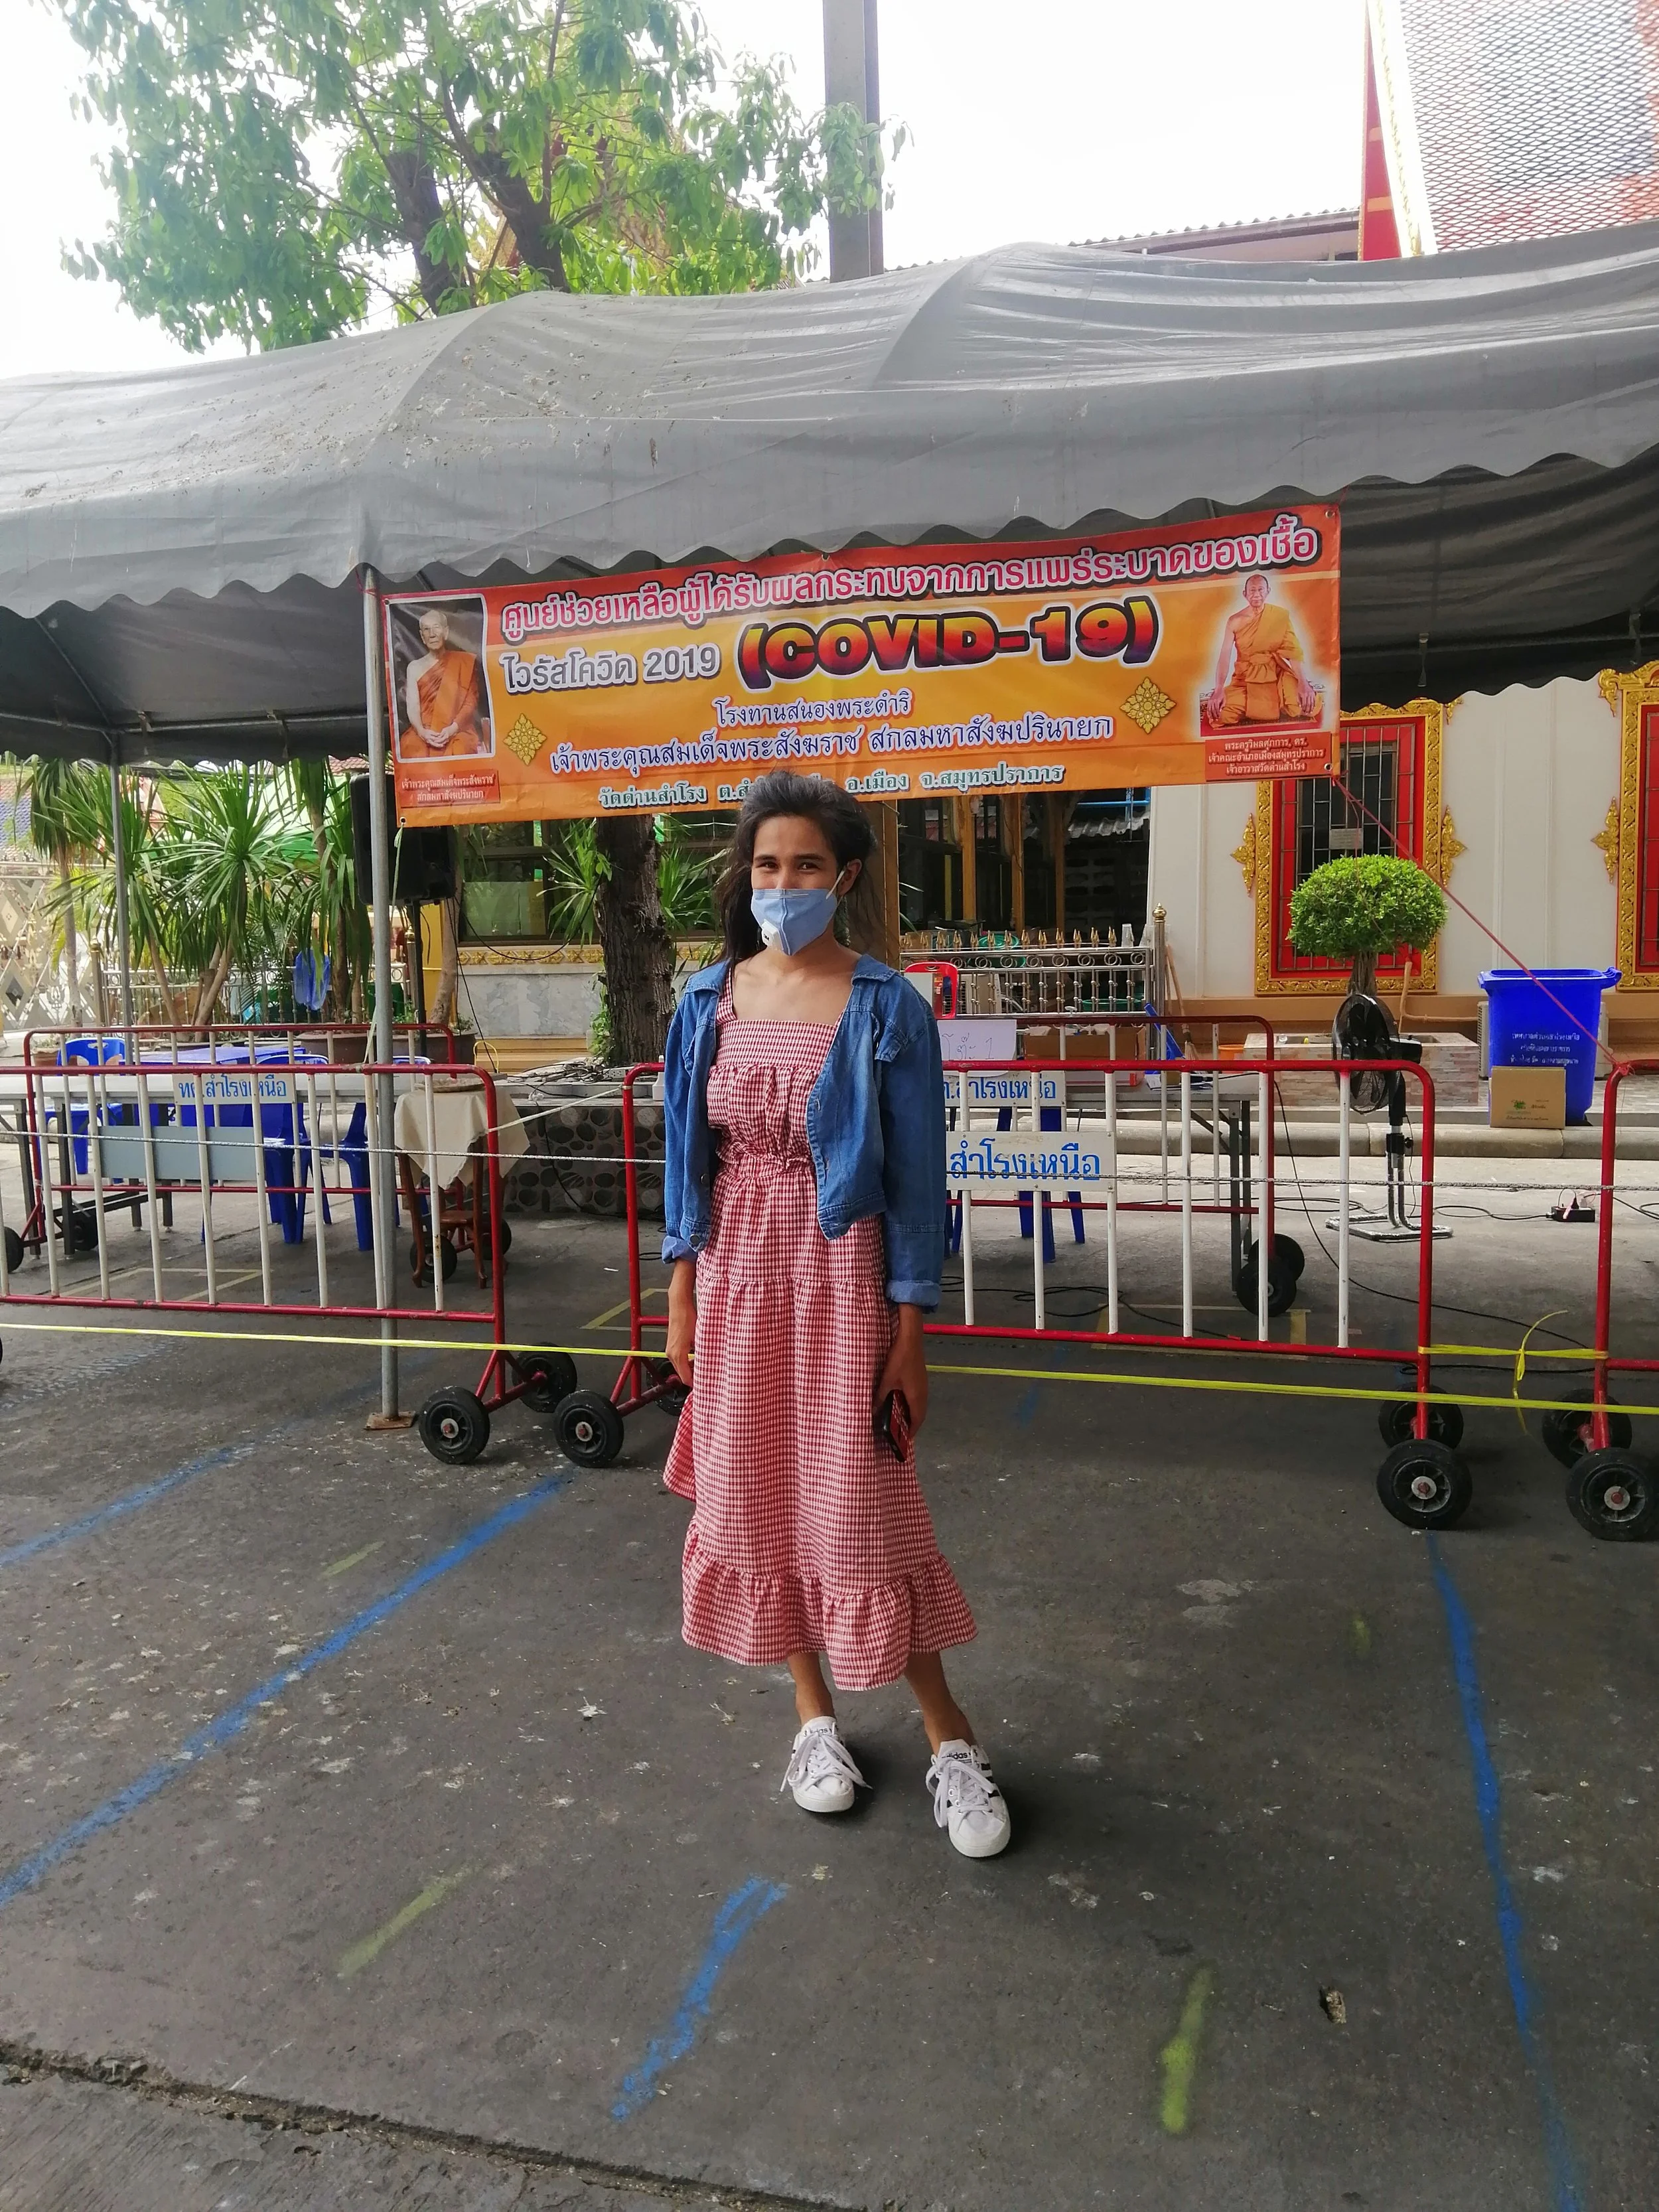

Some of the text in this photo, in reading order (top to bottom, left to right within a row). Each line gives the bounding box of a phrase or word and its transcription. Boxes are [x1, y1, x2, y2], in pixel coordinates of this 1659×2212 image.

[503, 515, 1317, 640] ศูนย์ช่วยเหลือผู้ได้รับผลกระทบจากการแพร่ระบาดของเชื้อ
[738, 597, 1157, 690] (COVID-19)
[502, 645, 717, 690] ไวรัสโควิด 2019
[715, 691, 910, 725] โรงทานสนองพระดำริ
[551, 713, 1112, 774] เจ้าพระคุณสมเด็จพระสังฆราช สกลมหาสังฆปรินายก
[600, 782, 705, 806] วัดด่านสำโรง
[847, 771, 907, 791] อ.เมือง
[920, 763, 1063, 790] จ.สมุทรปราการ
[985, 1037, 994, 1059] 1
[949, 1138, 1100, 1180] สำโรงเหนือ
